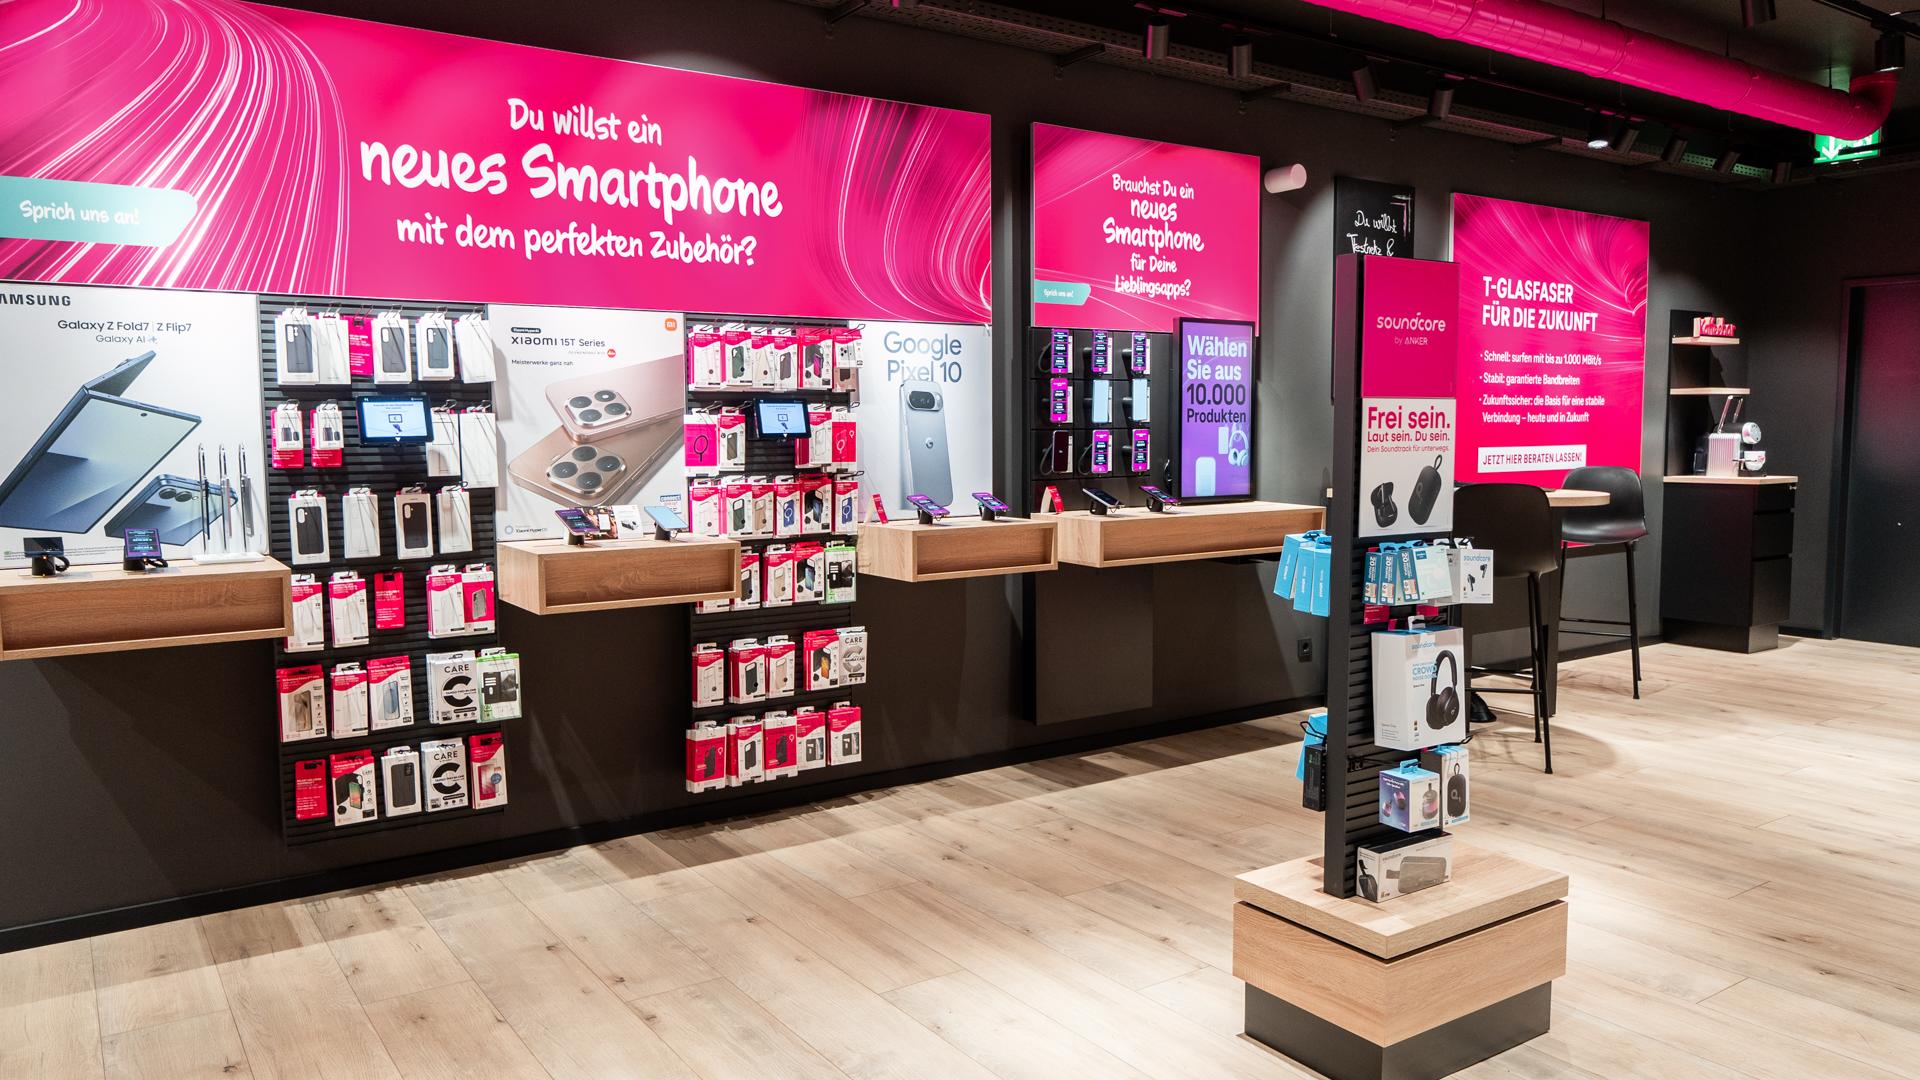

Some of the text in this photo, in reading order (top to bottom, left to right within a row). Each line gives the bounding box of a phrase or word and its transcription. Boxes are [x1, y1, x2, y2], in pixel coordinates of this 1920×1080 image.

[508, 98, 662, 146] Du willst ein
[360, 141, 783, 225] neues Smartphone
[1112, 173, 1194, 200] Brauchst Du ein
[19, 200, 140, 225] Sprich uns an!
[1130, 198, 1178, 222] neues
[1354, 210, 1397, 233] Du willst
[397, 212, 757, 266] mit dem perfekten Zubehör?
[1102, 217, 1204, 255] Smartphone
[1130, 252, 1177, 273] für Deine
[1114, 274, 1192, 300] Lieblingsapps?
[1482, 276, 1574, 304] T-GLASFASER
[0, 293, 71, 306] AMSUNG
[57, 319, 192, 334] Galaxy Z Fold7 Z Flip7
[1376, 312, 1447, 332] soundcore
[1482, 301, 1598, 332] FÜR DIE ZUKUNFT
[95, 334, 133, 344] Galaxy
[511, 336, 605, 347] xiaomi 15T Series
[884, 331, 962, 361] Google
[1187, 335, 1247, 358] Wählen
[1394, 336, 1428, 346] by ANKER
[1484, 350, 1511, 362] Schnell:
[1512, 352, 1532, 363] surfen
[1533, 353, 1544, 363] mit
[1545, 353, 1555, 364] bis
[1556, 356, 1563, 364] zu
[1564, 354, 1581, 365] 1.000
[887, 360, 962, 383] Pixel 10
[1187, 359, 1242, 381] Sie aus
[1483, 372, 1581, 386] Stabil: garantierte Bandbreiten
[1186, 383, 1246, 406] 10.000
[1483, 394, 1605, 406] Zukunftssicher: die Basis für eine stabile
[1187, 408, 1247, 424] Produkten
[1367, 405, 1450, 429] Frei sein.
[1482, 411, 1520, 425] Verbindung
[1527, 412, 1545, 422] heute
[1547, 412, 1559, 422] und
[1559, 412, 1566, 422] in
[1566, 411, 1590, 423] Zukunft
[1367, 430, 1450, 443] Laut sein. Du sein.
[1367, 445, 1380, 453] Dein
[1412, 444, 1420, 452] für
[1482, 451, 1582, 466] JETZT HIER BERATEN LASSEN!
[444, 664, 469, 673] CARE
[433, 751, 458, 760] CARE
